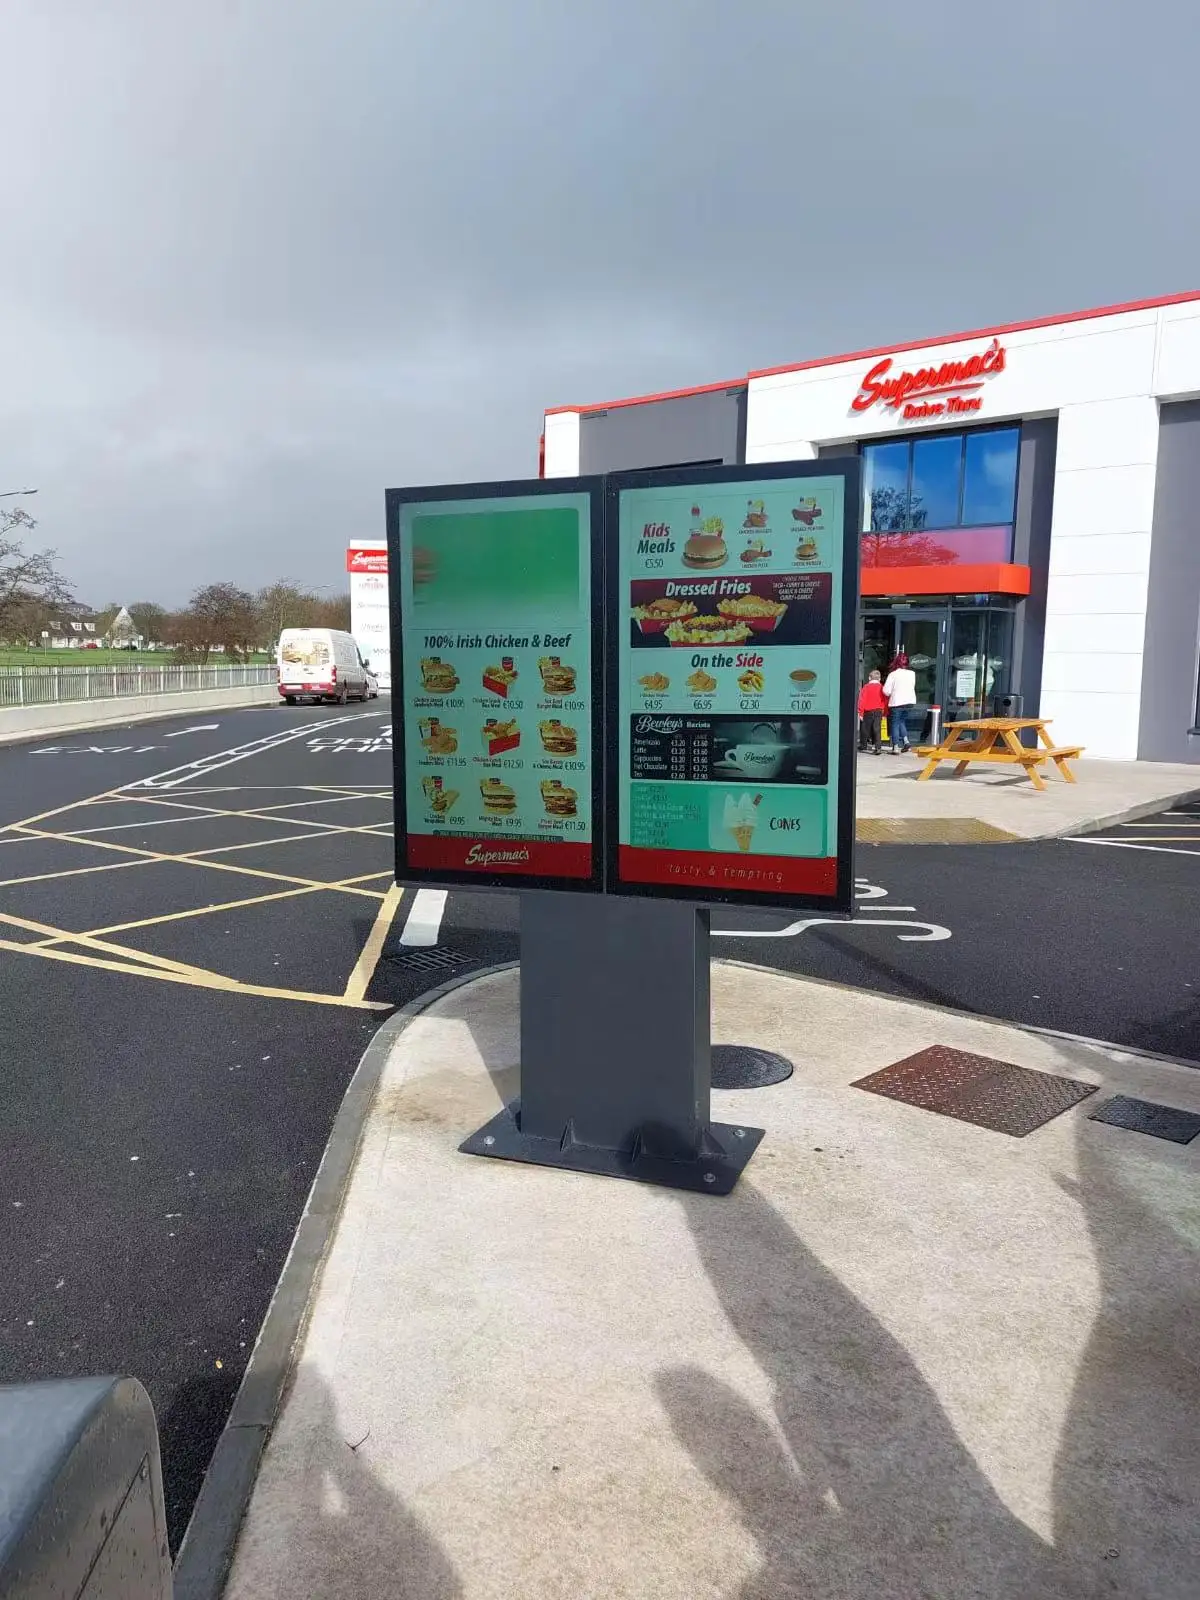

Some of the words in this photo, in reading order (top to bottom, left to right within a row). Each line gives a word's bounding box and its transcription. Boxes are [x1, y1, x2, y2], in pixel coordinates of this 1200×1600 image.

[852, 338, 1006, 411] Supermac's
[903, 401, 945, 419] Drive
[946, 396, 983, 412] Thru
[643, 523, 670, 538] Kids
[637, 538, 676, 554] Meals
[645, 558, 663, 569] €5.50
[666, 580, 717, 596] Dressed
[720, 579, 752, 595] Fries
[424, 636, 454, 649] 100%
[456, 635, 482, 648] Irish
[485, 634, 529, 648] Chicken
[531, 634, 540, 648] &
[543, 633, 572, 648] Beef
[691, 654, 708, 668] On
[711, 653, 733, 667] the
[736, 653, 764, 667] Side
[446, 698, 465, 708] €10.95
[503, 700, 523, 709] €10.50
[564, 700, 585, 710] €10.95
[645, 700, 663, 709] €4.95
[694, 700, 712, 709] €6.95
[740, 700, 759, 710] €2.30
[791, 700, 812, 710] €1.00
[635, 715, 683, 733] Bewley's
[686, 720, 711, 728] Barista
[503, 759, 524, 769] €12.50
[565, 760, 586, 771] €10.95
[449, 816, 465, 825] €9.95
[506, 818, 522, 828] €9.95
[565, 821, 586, 831] €11.50
[769, 818, 801, 830] CONES
[465, 843, 529, 866] Supermac's
[708, 865, 716, 876] &
[724, 866, 783, 883] tempting
